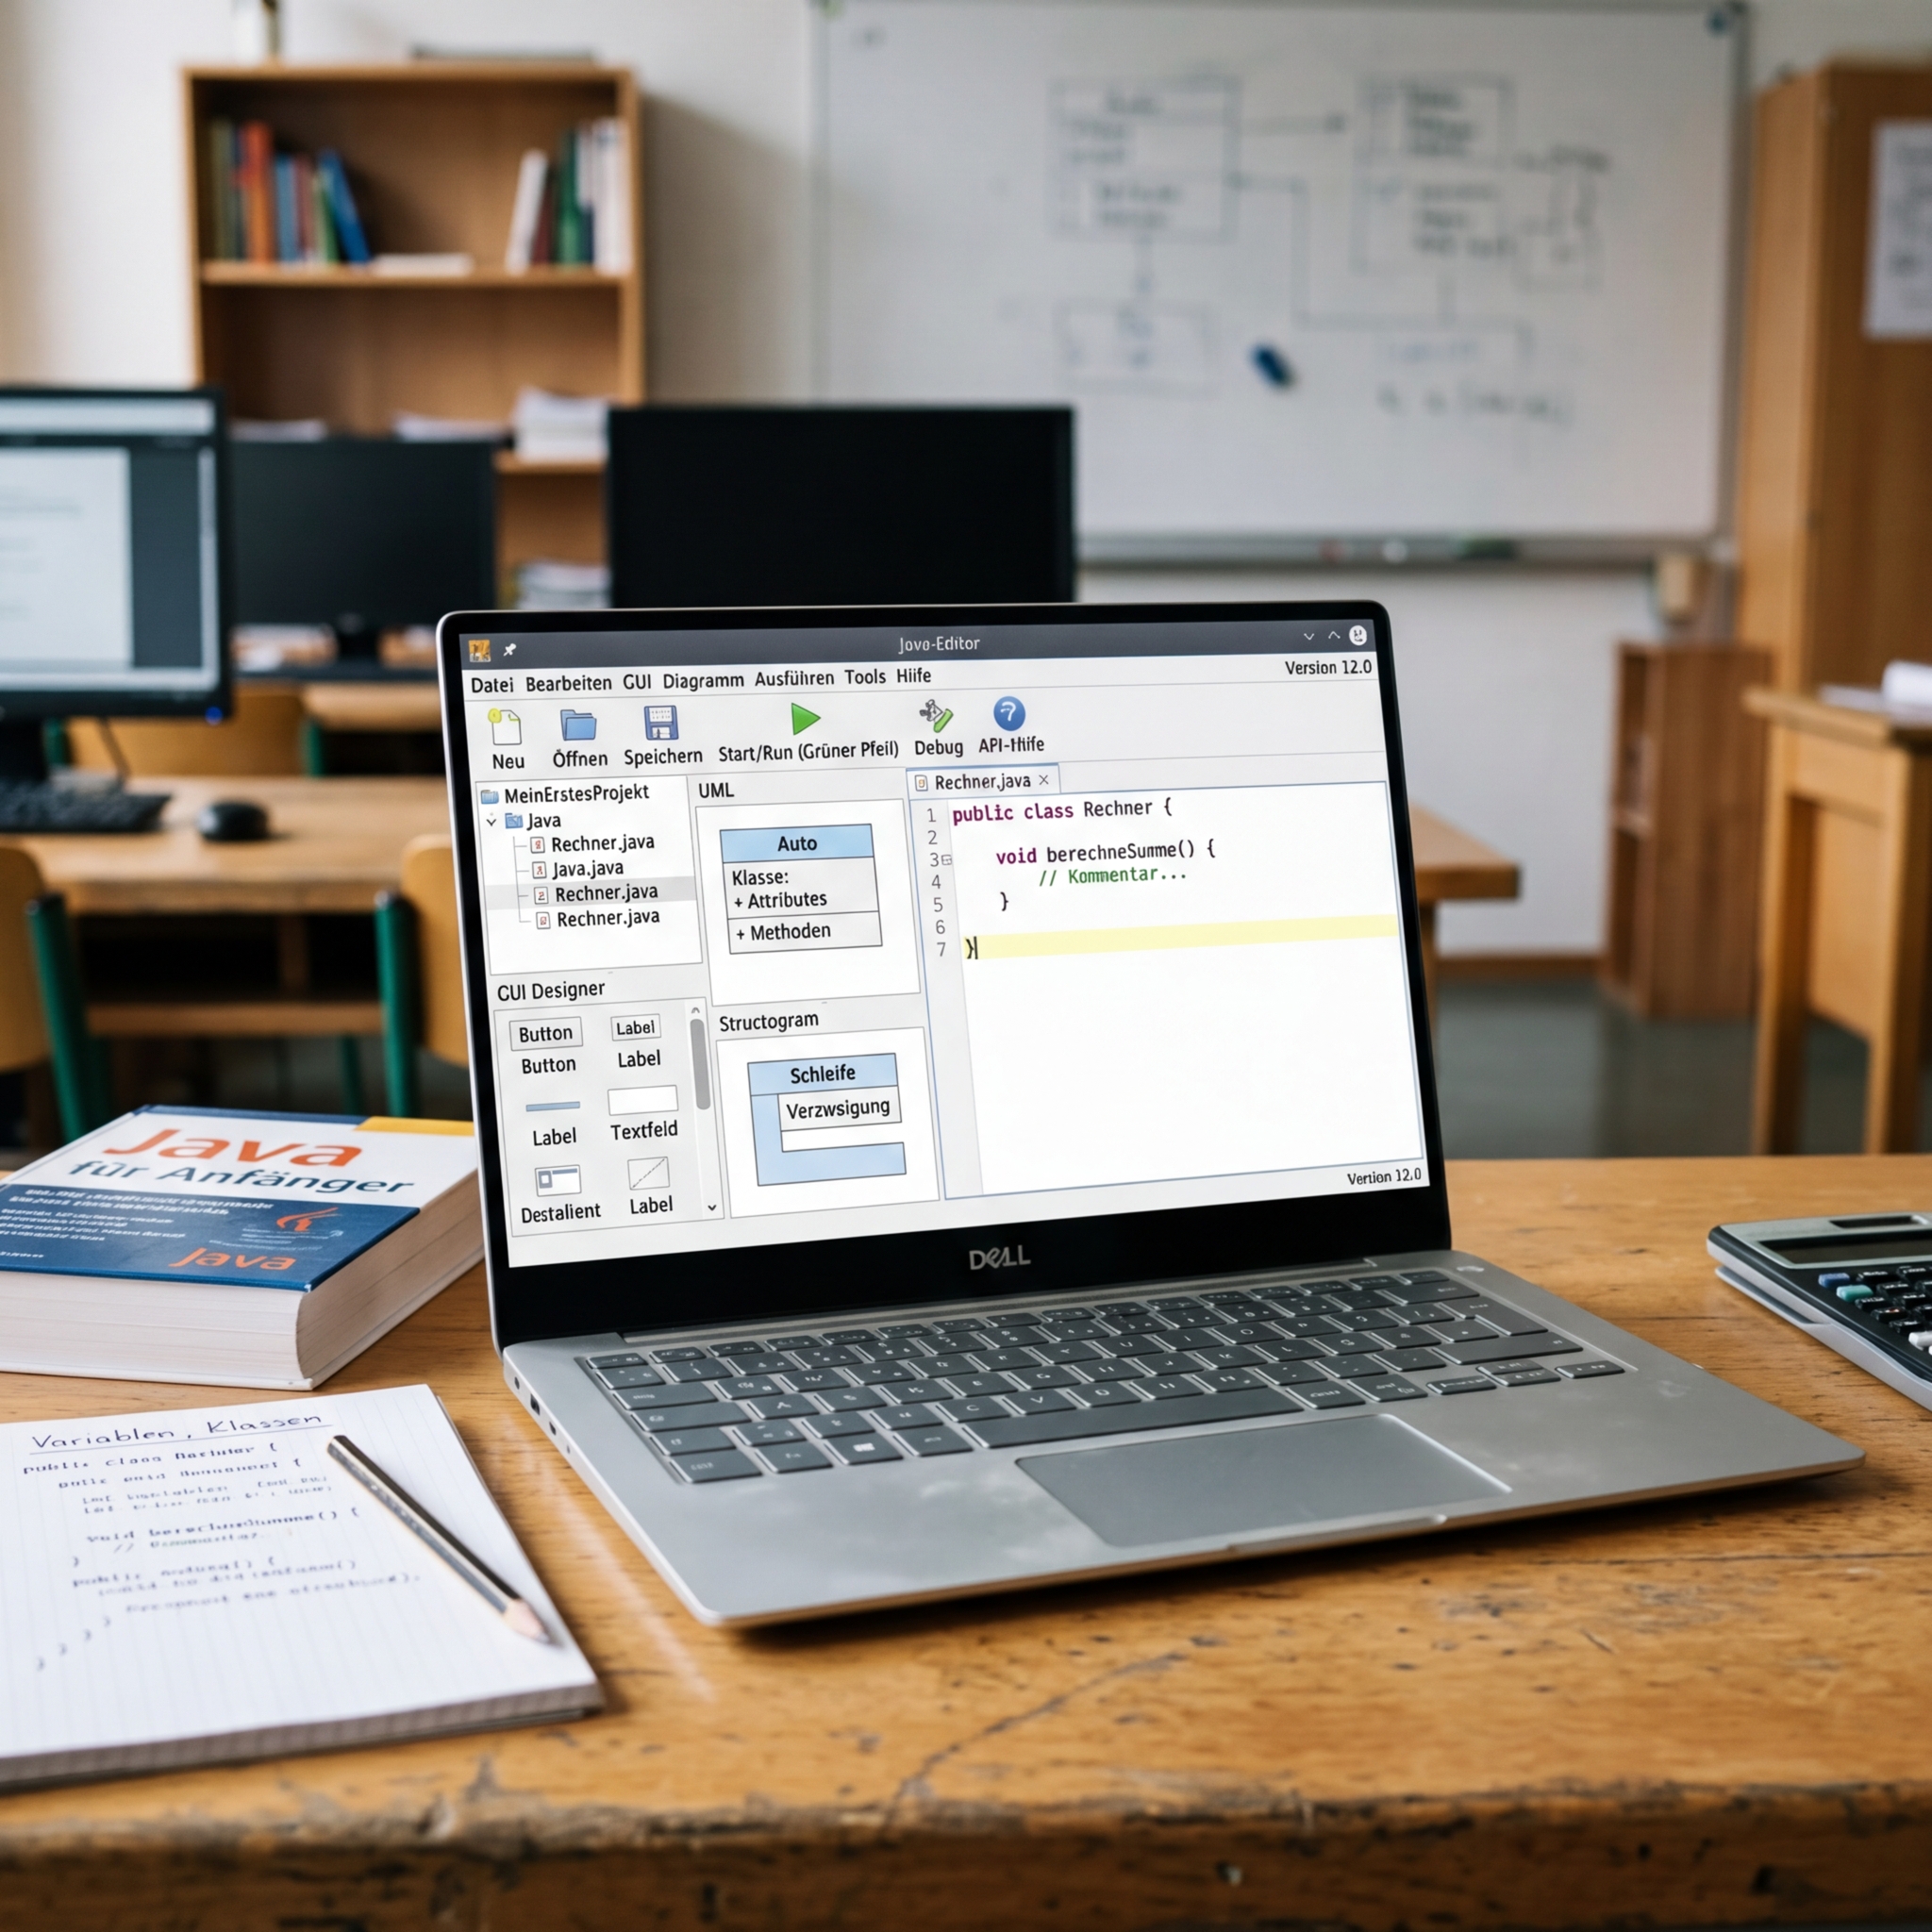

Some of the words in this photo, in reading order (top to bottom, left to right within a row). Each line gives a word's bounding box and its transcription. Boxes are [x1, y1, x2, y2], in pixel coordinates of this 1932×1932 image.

[1284, 659, 1338, 675] Version
[1341, 658, 1373, 675] 12.0
[471, 676, 514, 693] Datei
[525, 675, 612, 692] Bearbeiten
[623, 674, 652, 691] GUI
[663, 673, 745, 692] Diagramm
[844, 668, 887, 685] Tools
[552, 748, 608, 769] Öffnen
[624, 747, 704, 768] Speichern
[718, 744, 793, 763] Start/Run
[798, 742, 857, 762] (Grüner
[860, 740, 899, 759] Pfeil)
[914, 739, 964, 758] Debug
[491, 753, 525, 770] Neu
[698, 781, 735, 799] UML
[935, 773, 1032, 792] Rechner.java
[504, 782, 650, 805] MeinErstesProjekt
[926, 808, 937, 823] 1
[952, 804, 1014, 826] public
[1024, 802, 1074, 820] class
[1083, 799, 1153, 818] Rechner
[1163, 796, 1173, 817] {
[525, 812, 562, 832] Java
[551, 833, 656, 854] Rechner.java
[777, 835, 818, 852] Auto
[927, 829, 938, 845] 2
[929, 852, 941, 868] 3
[995, 846, 1038, 865] void
[1046, 839, 1194, 863] berechneSumme()
[1207, 838, 1216, 858] {
[551, 859, 625, 881] Java.java
[732, 869, 789, 887] Klasse:
[931, 874, 941, 890] 4
[1039, 869, 1058, 887] //
[554, 882, 658, 904] Rechner.java
[747, 891, 829, 911] Attributes
[933, 896, 943, 913] 5
[999, 891, 1009, 912] }
[557, 908, 660, 929] Rechner.java
[935, 919, 946, 935] 6
[749, 921, 831, 941] Methoden
[936, 941, 946, 958] 7
[531, 980, 606, 1002] Designer
[719, 1013, 819, 1033] Structogram
[519, 1026, 574, 1044] Button
[521, 1058, 576, 1074] Button
[618, 1048, 661, 1069] Label
[791, 1063, 857, 1085] Schleife
[786, 1099, 892, 1121] Verzwsigung
[532, 1126, 577, 1147] Label
[609, 1119, 678, 1141] Textfeld
[103, 1128, 362, 1167] Java
[68, 1160, 149, 1178] für
[155, 1164, 415, 1196] Anfänger
[1395, 1167, 1422, 1182] 12.0
[521, 1203, 602, 1224] Destalient
[629, 1194, 674, 1215] Label
[169, 1247, 296, 1270] Java
[968, 1244, 1032, 1271] DELL
[31, 1427, 175, 1449] Variablen
[207, 1415, 323, 1434] Klassen
